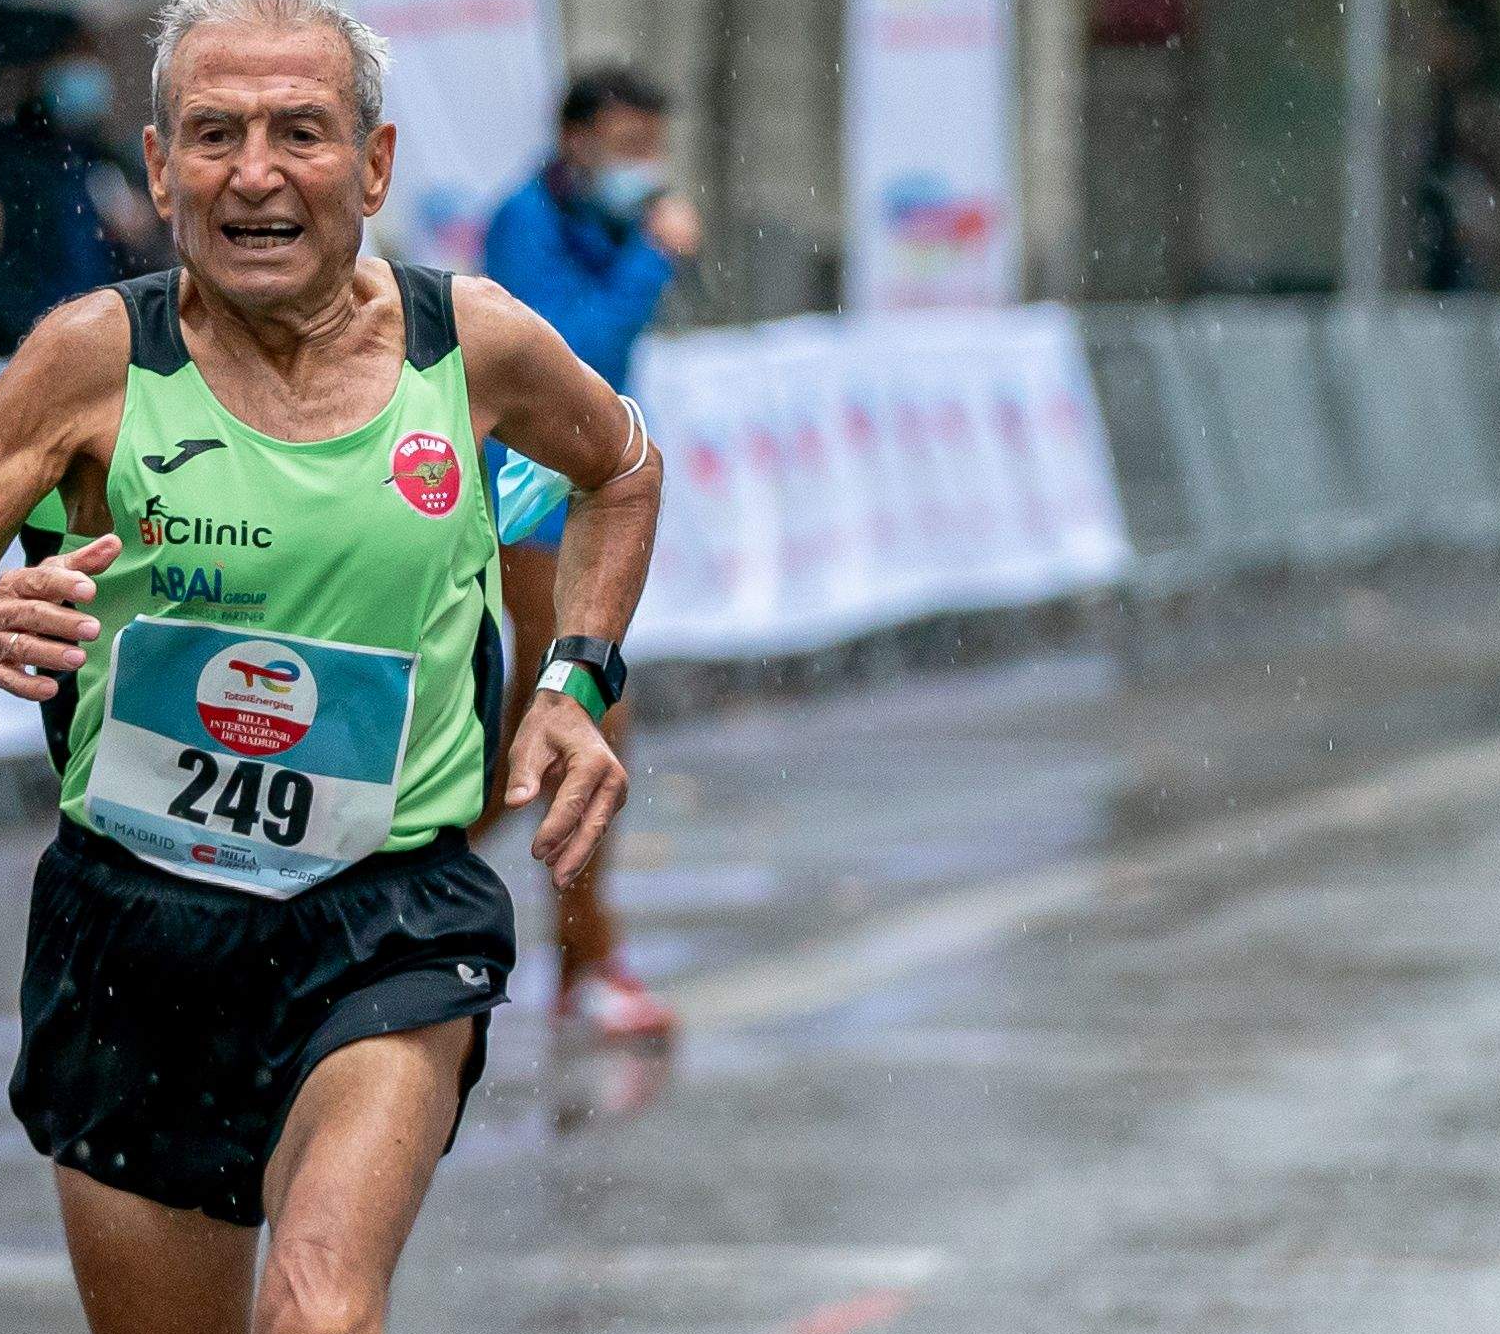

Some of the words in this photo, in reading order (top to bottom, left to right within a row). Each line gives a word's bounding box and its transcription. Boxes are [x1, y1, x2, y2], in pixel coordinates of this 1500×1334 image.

[139, 517, 273, 549] BiClinic
[224, 691, 294, 711] TotalEnergies
[236, 713, 271, 727] MILLA
[221, 731, 236, 742] DE
[238, 734, 281, 749] MADRID
[167, 748, 314, 847] 249
[114, 821, 175, 850] MADRID
